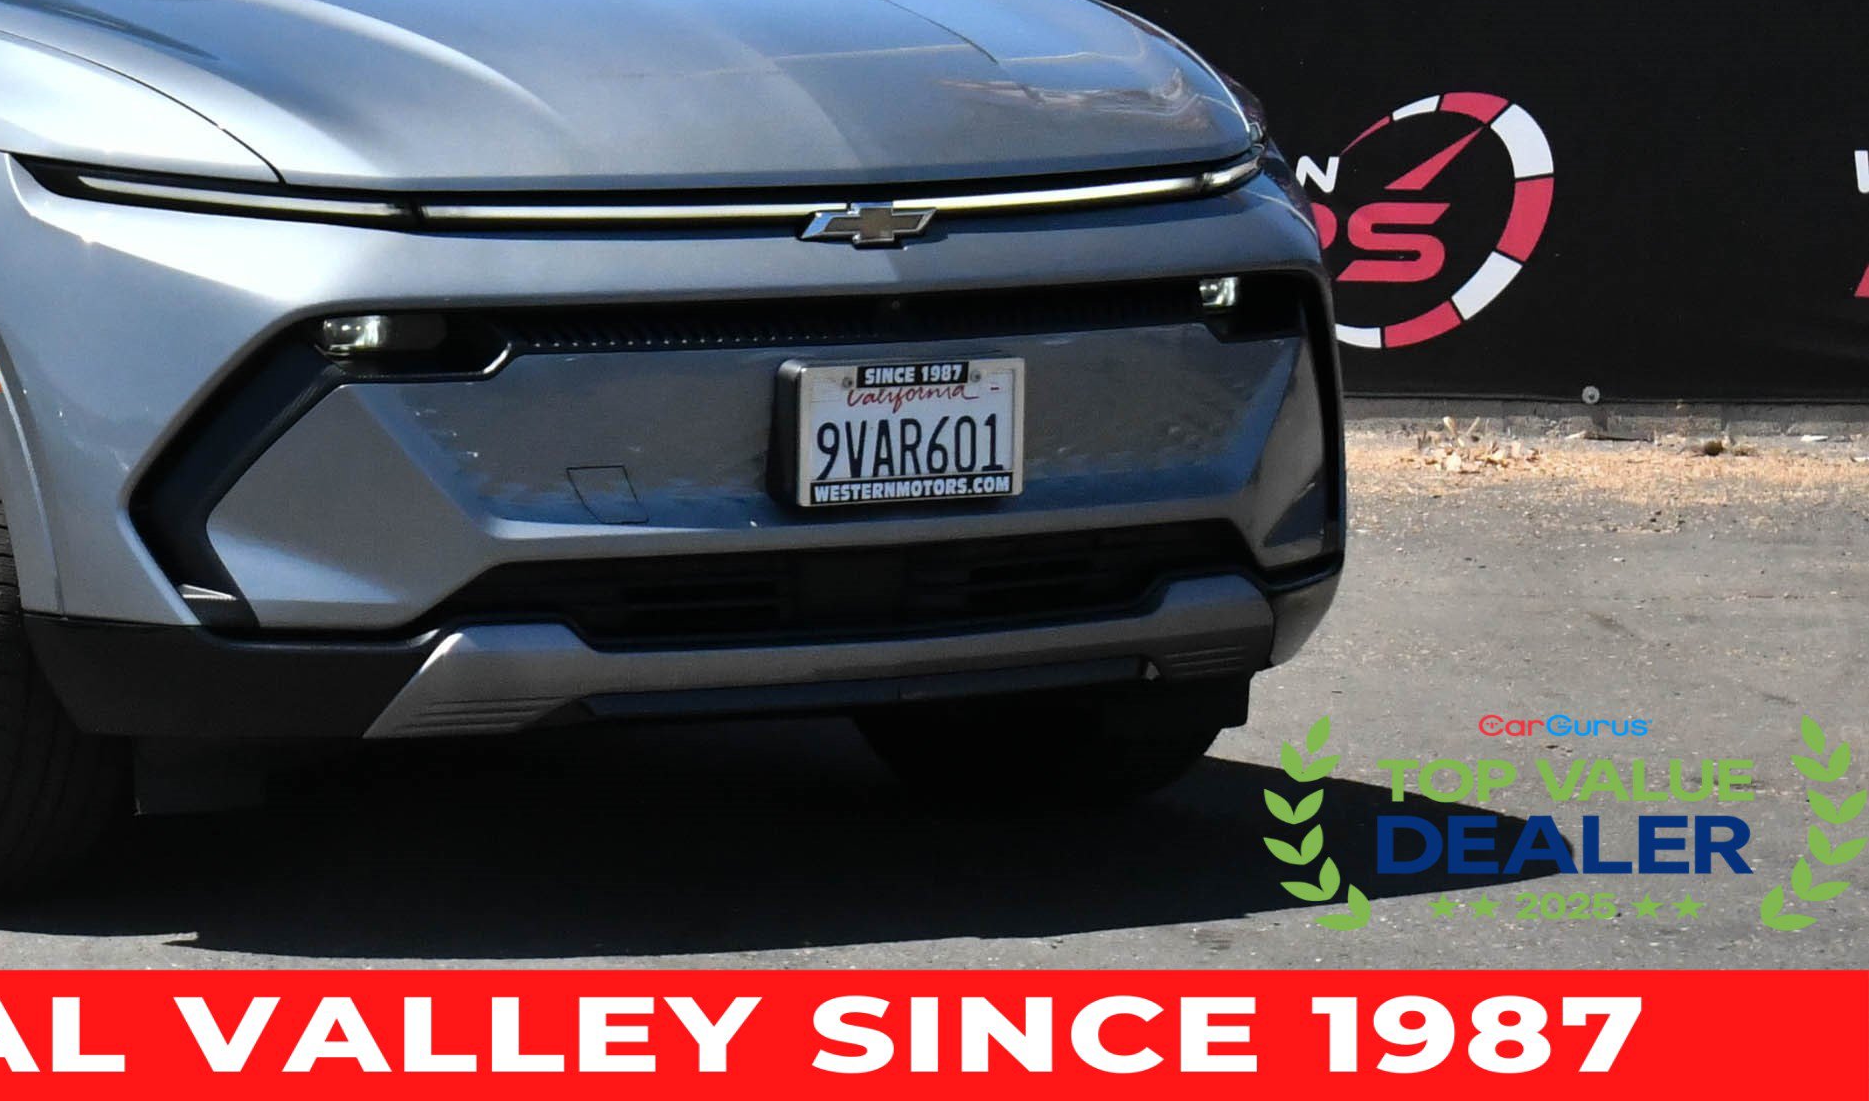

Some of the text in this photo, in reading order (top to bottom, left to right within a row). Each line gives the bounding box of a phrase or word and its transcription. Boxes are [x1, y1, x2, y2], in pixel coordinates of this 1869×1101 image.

[864, 363, 962, 385] SINCE 1987
[847, 383, 980, 414] California
[816, 413, 1004, 481] 9VAR601
[814, 475, 1010, 503] WESTERNMOTORS.COM
